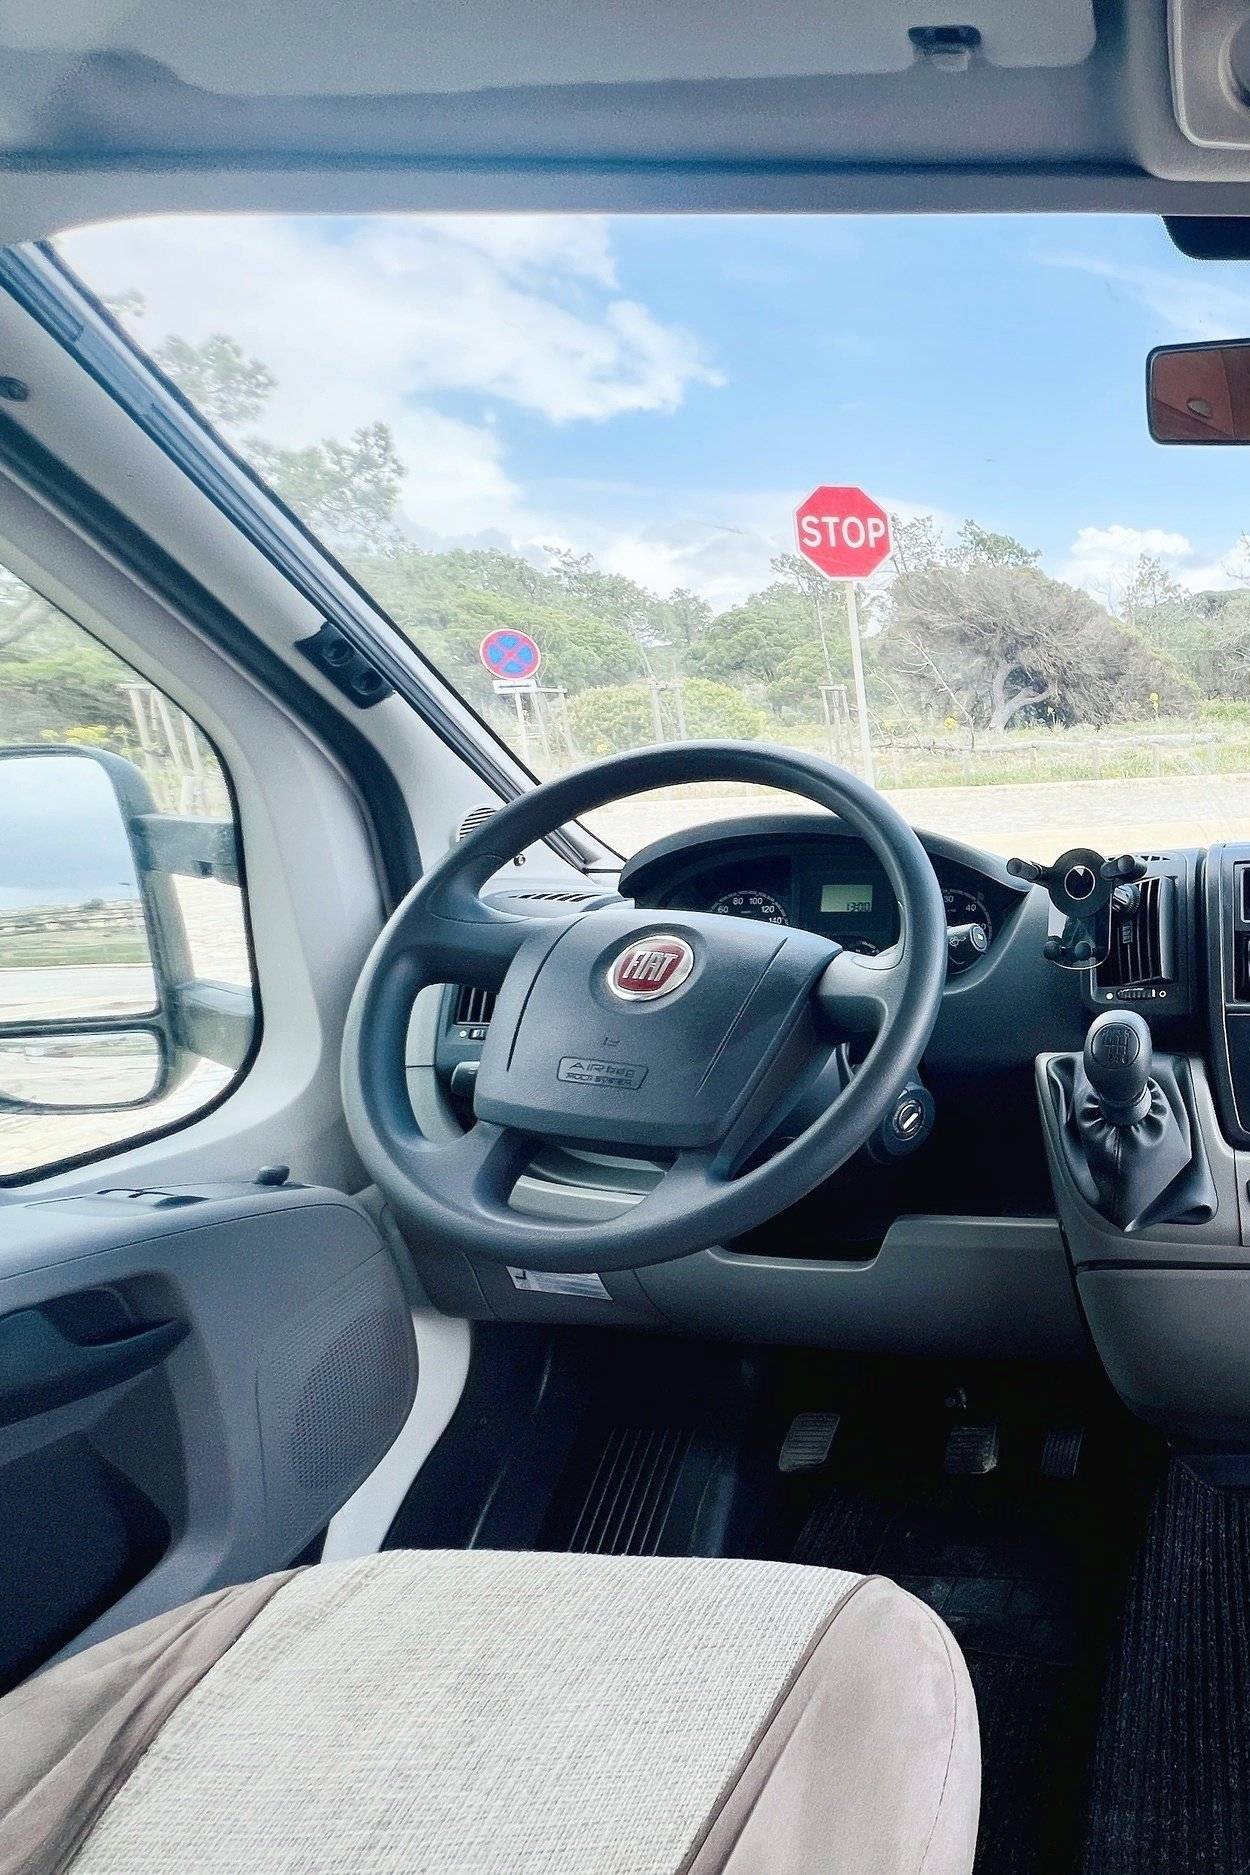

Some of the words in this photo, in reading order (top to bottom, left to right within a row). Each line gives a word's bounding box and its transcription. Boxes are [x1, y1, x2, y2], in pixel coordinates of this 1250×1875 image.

[801, 515, 886, 549] STOP
[732, 897, 744, 906] 80
[749, 897, 763, 905] 100
[761, 905, 775, 913] 120
[965, 903, 977, 912] 40
[622, 950, 679, 982] FIAT
